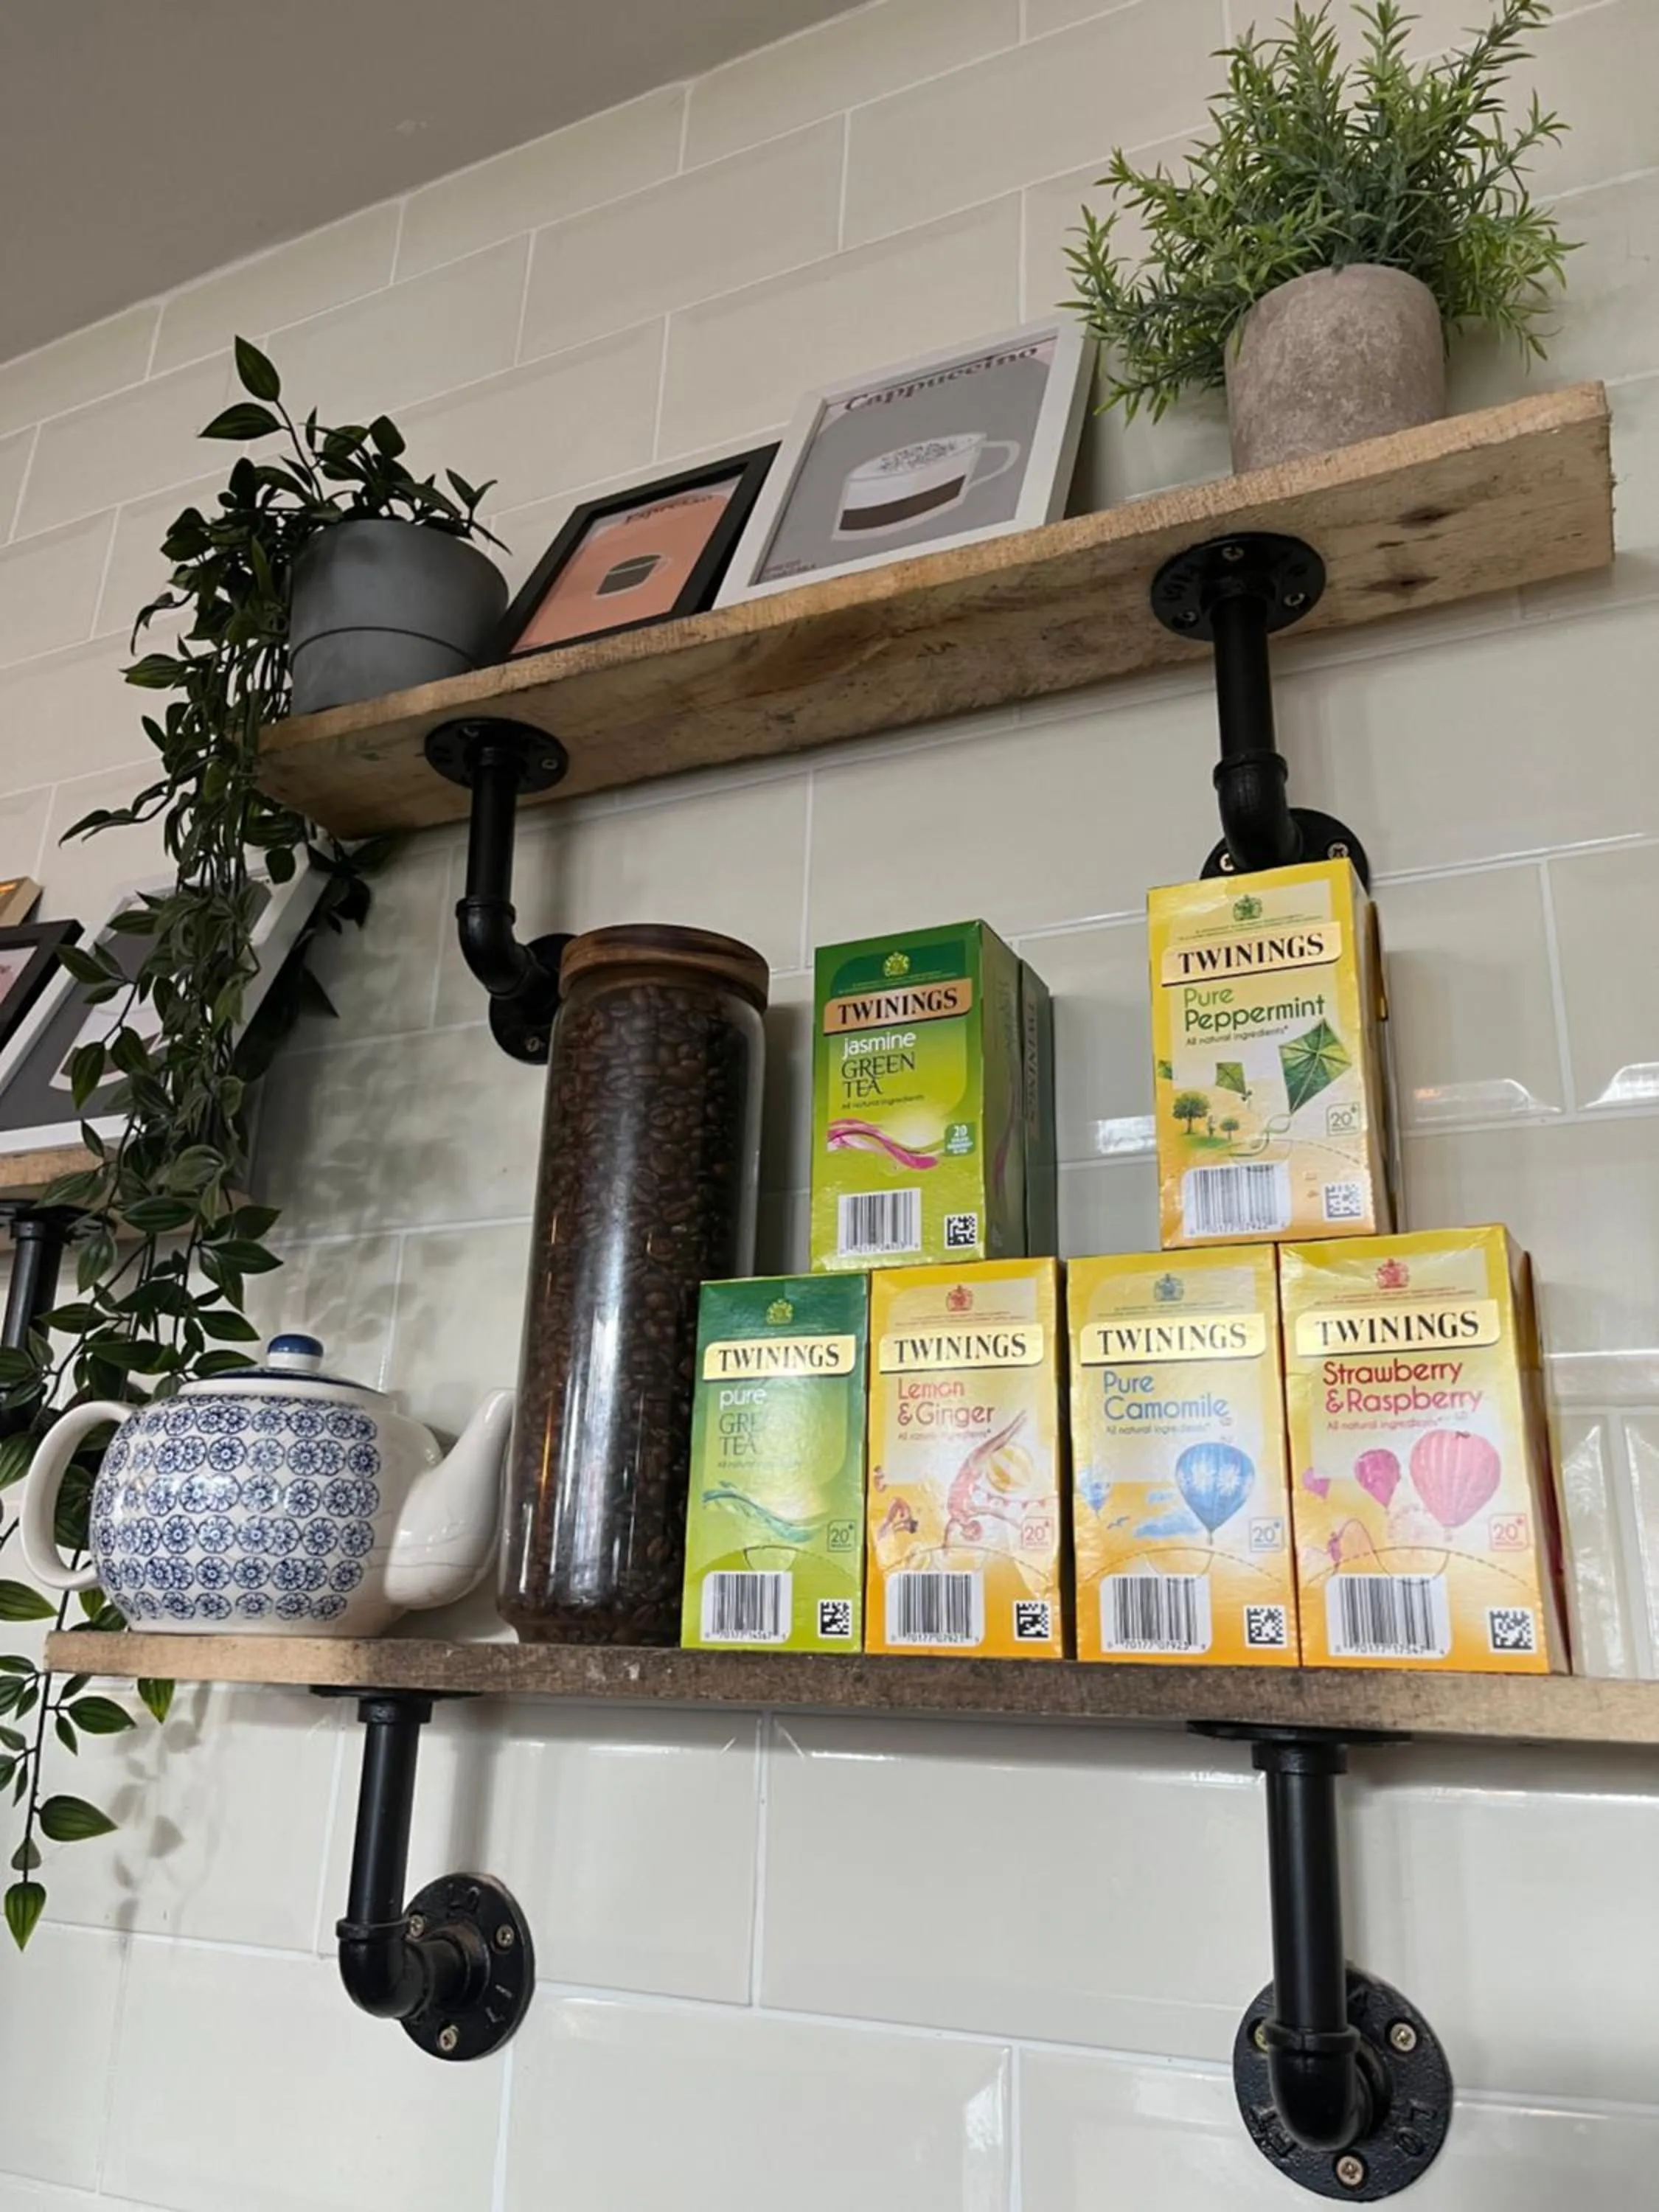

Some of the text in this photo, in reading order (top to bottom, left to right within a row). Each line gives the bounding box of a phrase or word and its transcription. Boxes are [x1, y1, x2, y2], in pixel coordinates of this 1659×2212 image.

[1178, 933, 1324, 974] TWININGS
[838, 988, 958, 1025] TWININGS
[1184, 987, 1234, 1009] Pure
[1184, 994, 1325, 1033] Peppermint
[843, 1032, 917, 1060] jasmine
[841, 1051, 916, 1079] GREEN
[843, 1077, 883, 1099] TEA
[1330, 1112, 1353, 1127] 20
[1097, 1323, 1246, 1355] TWININGS
[1315, 1310, 1480, 1346] TWININGS
[718, 1343, 839, 1372] TWININGS
[894, 1333, 1026, 1364] TWININGS
[1104, 1370, 1154, 1394] Pure
[1323, 1358, 1462, 1386] Strawberry
[720, 1388, 767, 1411] pure
[897, 1378, 965, 1400] Lemon
[1105, 1393, 1230, 1420] Camomile
[719, 1432, 759, 1456] TEA
[831, 1528, 849, 1544] 20
[1253, 1526, 1276, 1543] 20
[1493, 1523, 1518, 1541] 20
